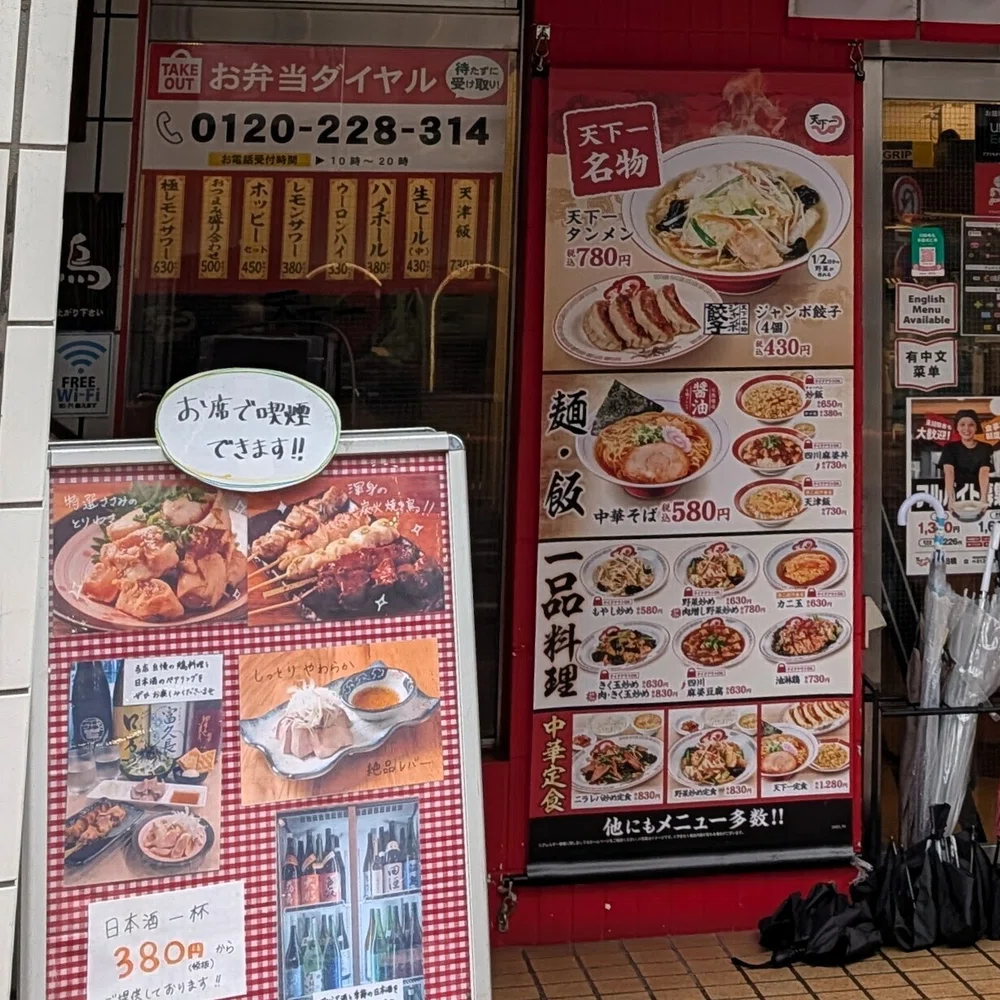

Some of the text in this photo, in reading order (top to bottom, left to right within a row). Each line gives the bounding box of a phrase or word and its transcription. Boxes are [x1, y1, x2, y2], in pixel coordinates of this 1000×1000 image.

[161, 63, 199, 76] TAKE
[455, 61, 499, 76] 待たずに
[164, 77, 196, 91] OUT
[209, 62, 437, 94] お弁当ダイヤル
[191, 112, 489, 146] 0120-228-314
[578, 121, 649, 147] 天下一
[221, 154, 299, 166] お電話受付時間
[580, 148, 649, 184] 名物
[159, 178, 179, 260] 極レモンサワー
[207, 178, 225, 260] おつまみ盛り合わせ
[250, 182, 269, 243] ホッピー
[288, 182, 307, 258] レモンサワー
[334, 182, 349, 259] ウーロンハイ
[412, 185, 431, 246] 生ビール
[456, 186, 473, 239] 天津飯
[566, 209, 618, 225] 天下一
[566, 227, 634, 242] タンメン
[577, 247, 631, 267] 780円
[908, 295, 945, 305] English
[755, 305, 841, 318] ジャンボ餃子
[912, 305, 941, 314] Menu
[903, 315, 951, 325] Available
[764, 339, 811, 356] 430円
[905, 350, 947, 364] 有中文
[913, 365, 941, 378] 菜单
[62, 376, 96, 388] FREE
[56, 387, 100, 403] Wi-Fi
[177, 394, 311, 426] お席で喫煙
[207, 437, 306, 460] できます!!
[593, 507, 658, 525] 中華そば
[672, 500, 731, 522] 580円
[682, 598, 716, 606] 野菜炒め
[592, 607, 634, 617] もやし炒め
[541, 550, 585, 699] 一品料理
[687, 687, 724, 698] 麻婆豆腐
[541, 715, 566, 813] 中華定食
[674, 786, 717, 798] 野菜炒め定食
[772, 782, 808, 793] 天下一定食
[602, 807, 784, 837] 他にもメニュー多数!!
[114, 940, 204, 979] 380円
